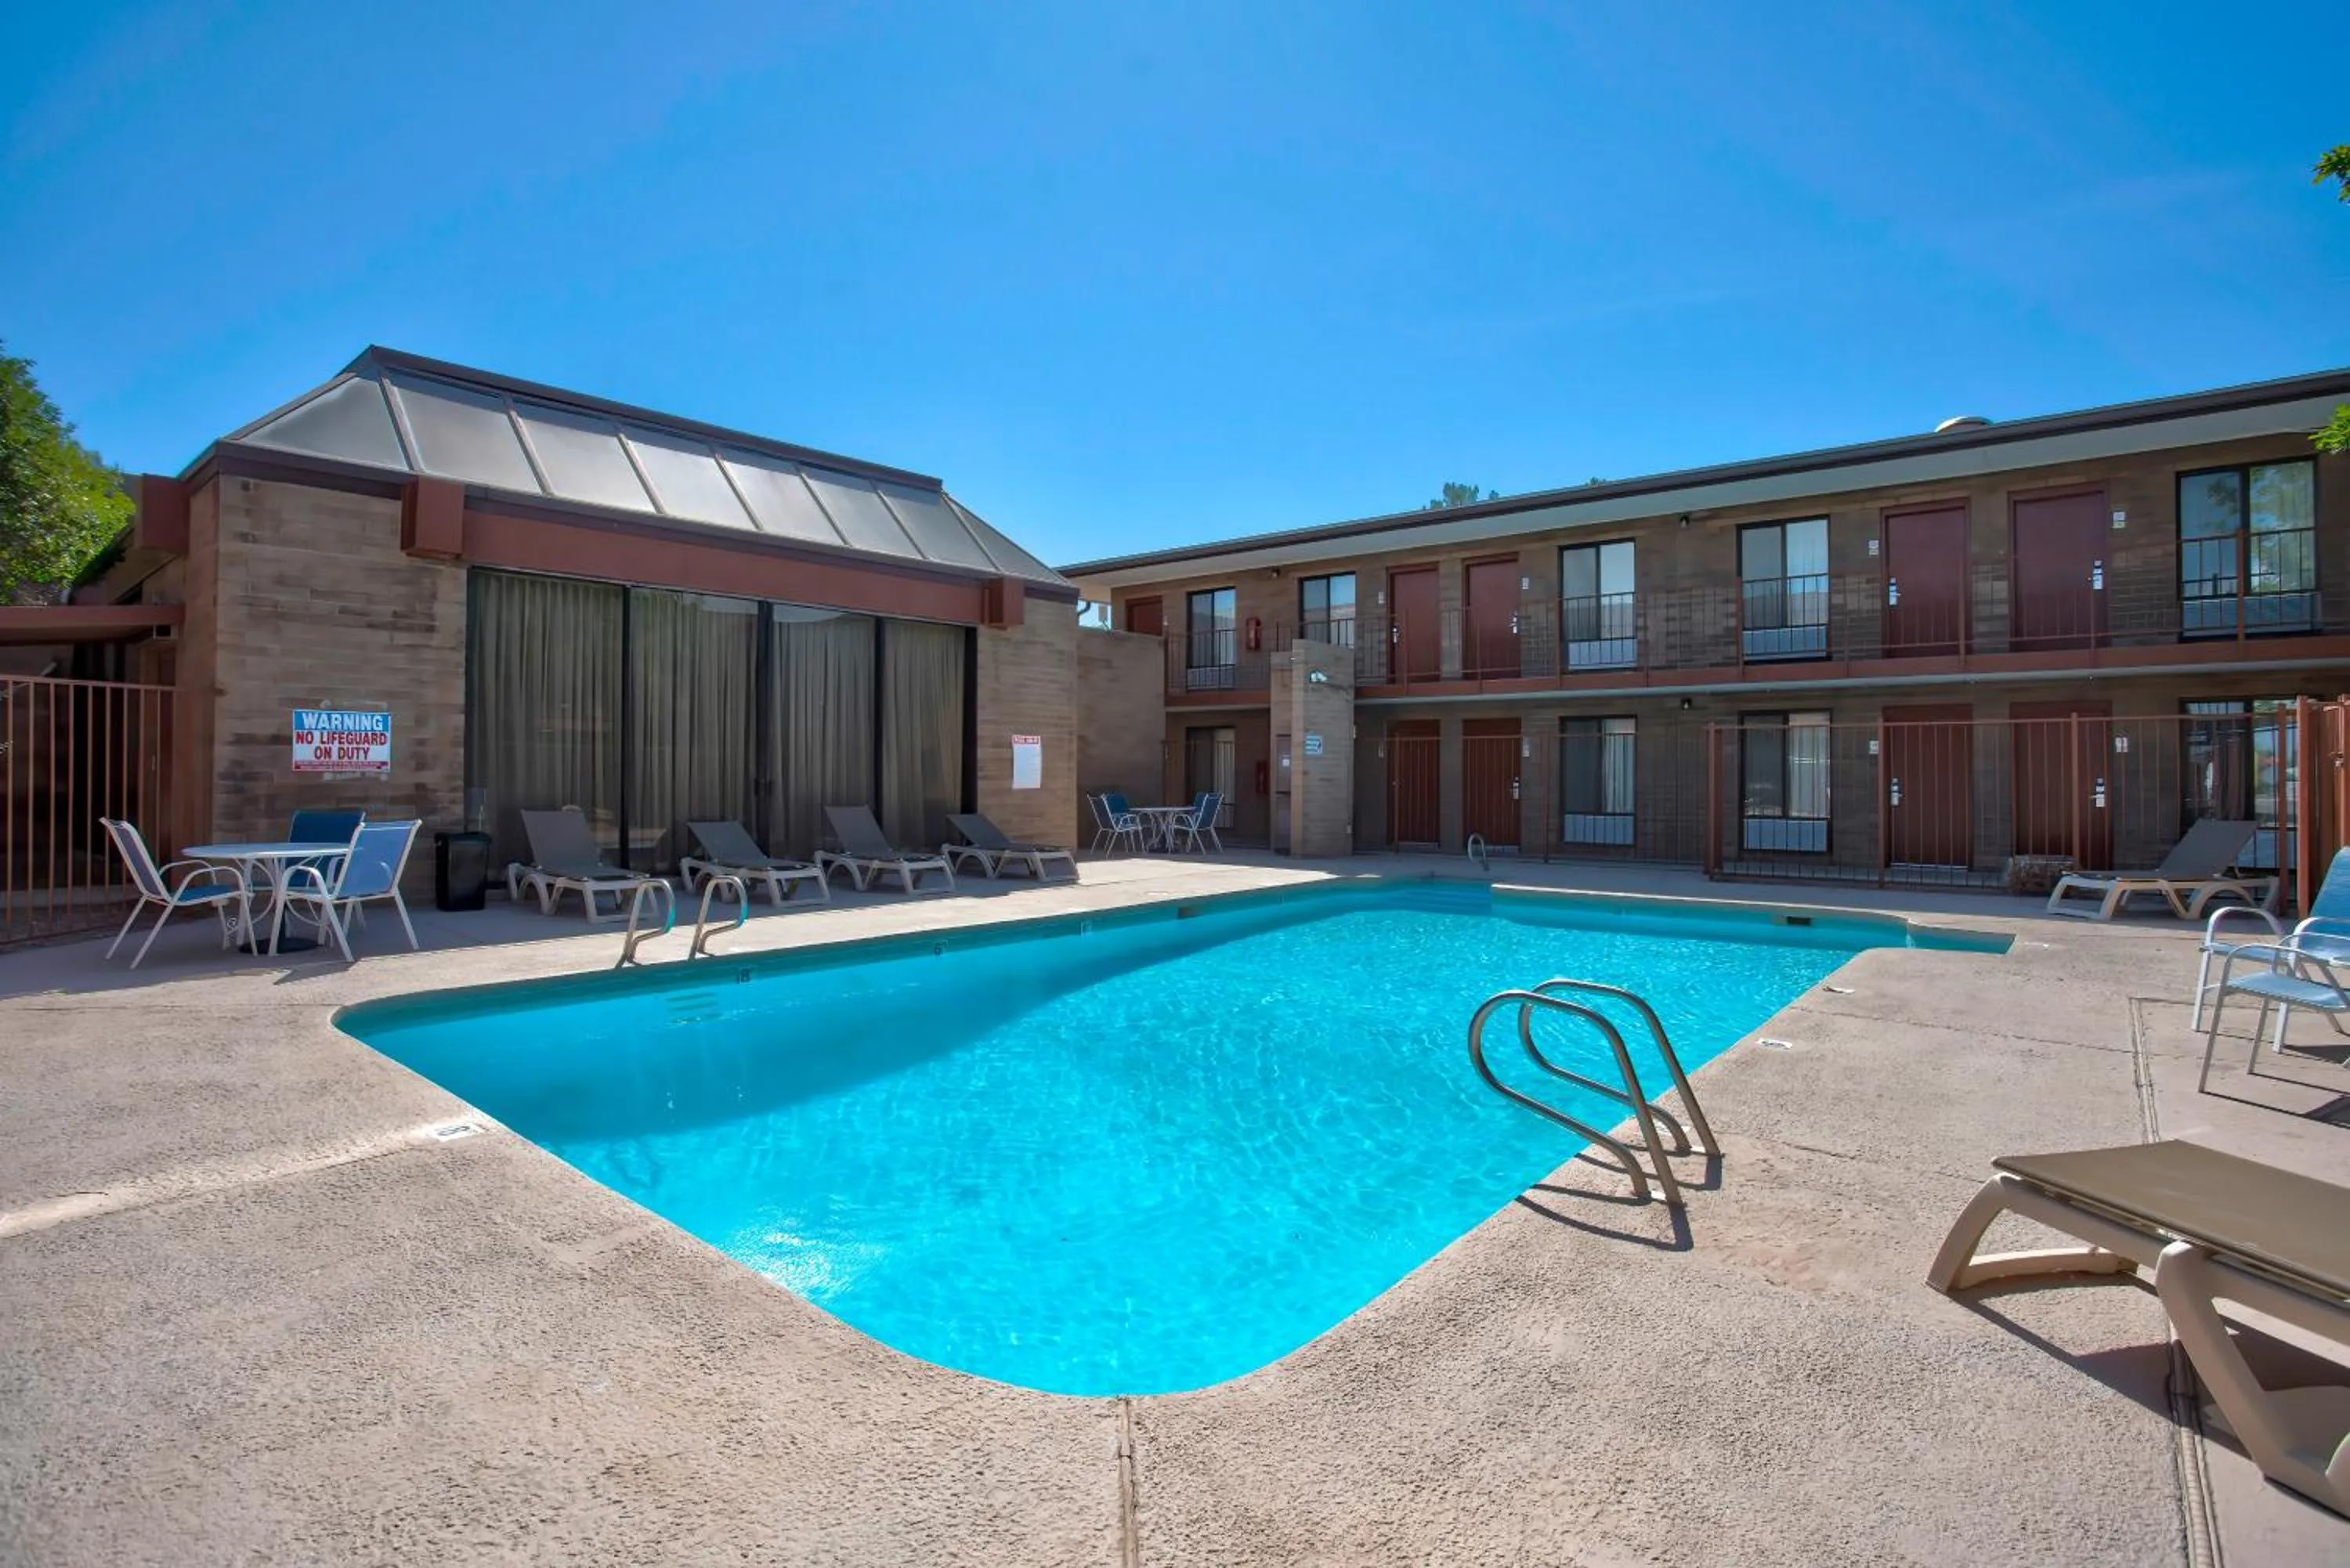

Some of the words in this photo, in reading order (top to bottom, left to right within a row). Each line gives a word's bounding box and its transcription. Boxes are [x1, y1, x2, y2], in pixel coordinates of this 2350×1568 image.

[302, 712, 383, 731] WARNING
[295, 732, 313, 744] NO
[320, 732, 387, 745] LIFEGUARD
[314, 746, 332, 760] ON
[338, 746, 371, 760] DUTY
